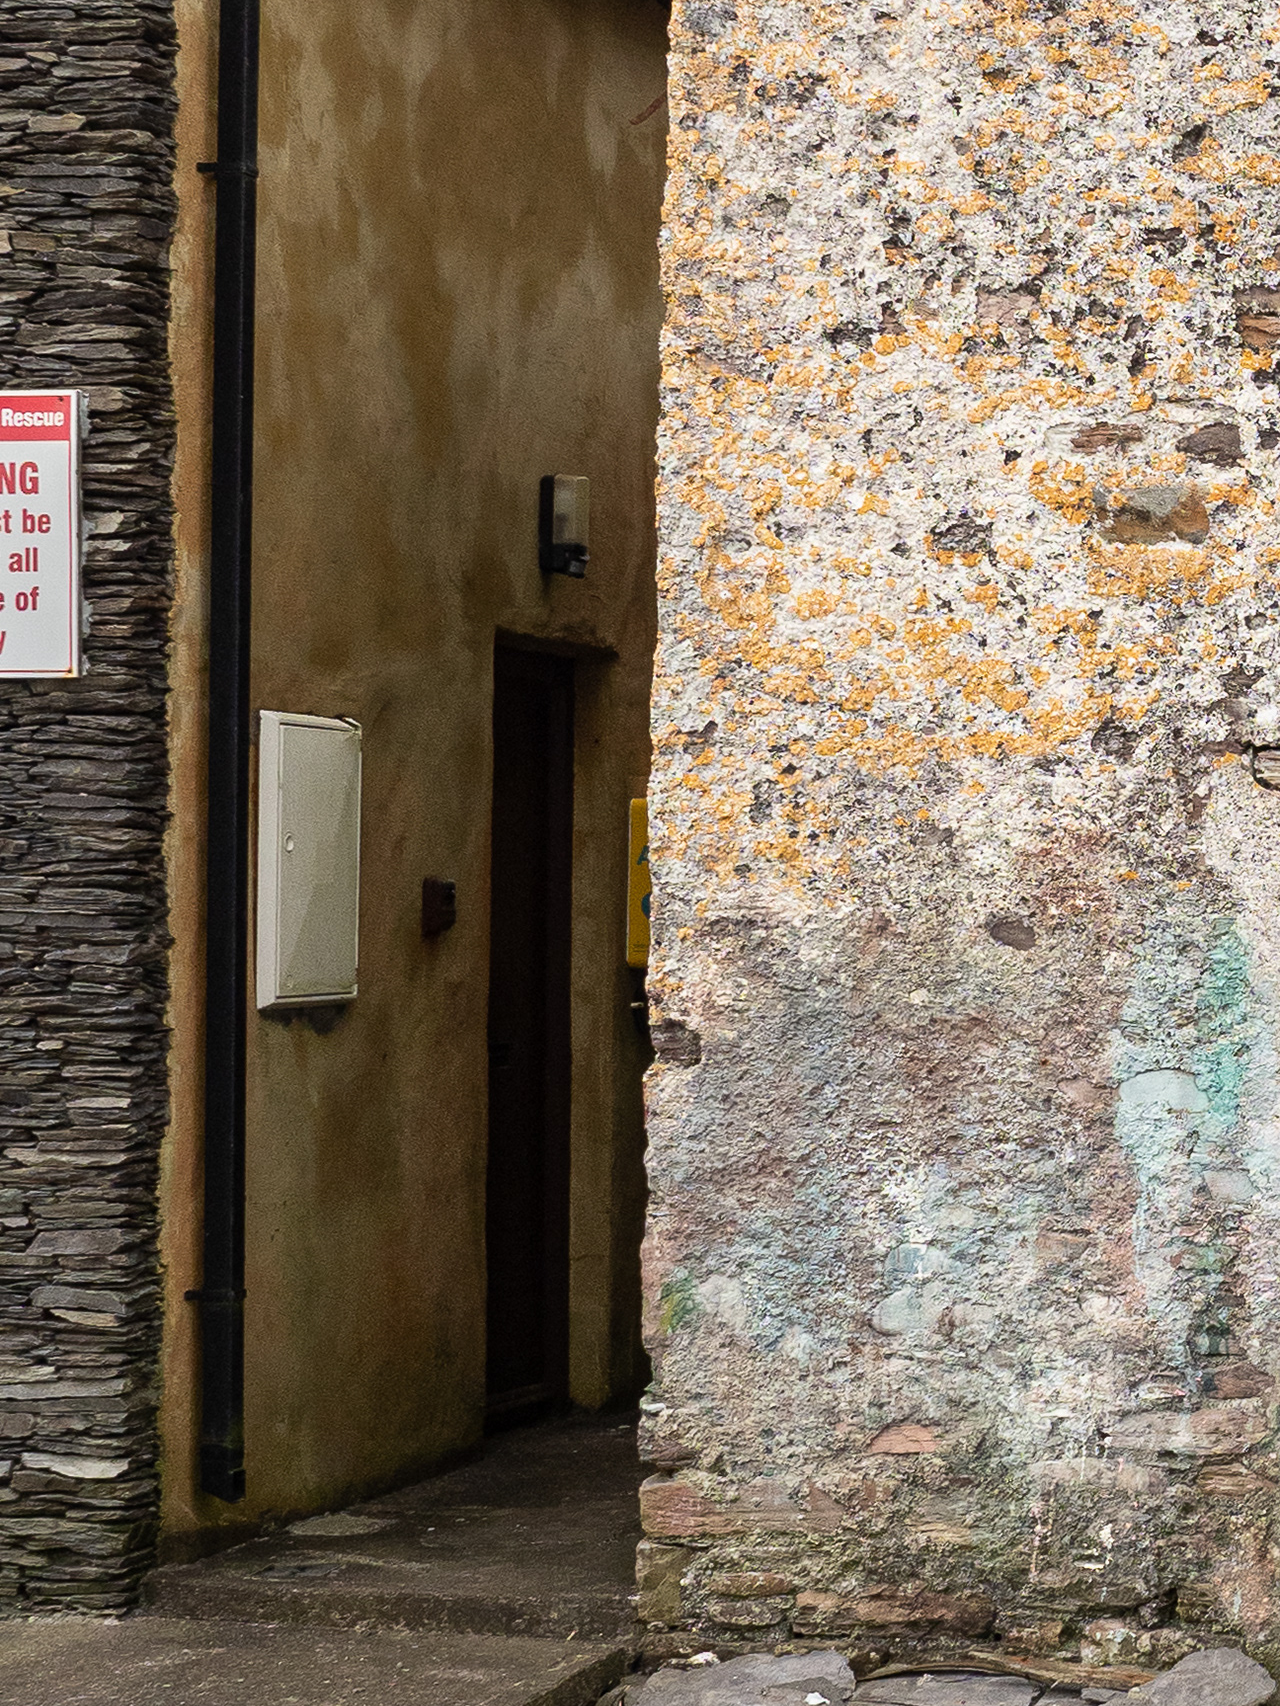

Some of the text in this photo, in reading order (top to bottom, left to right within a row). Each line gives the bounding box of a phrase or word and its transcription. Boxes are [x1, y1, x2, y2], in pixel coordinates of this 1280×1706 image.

[1, 408, 64, 427] Rescue
[22, 508, 51, 534] be
[8, 547, 39, 573] all
[15, 586, 40, 611] of
